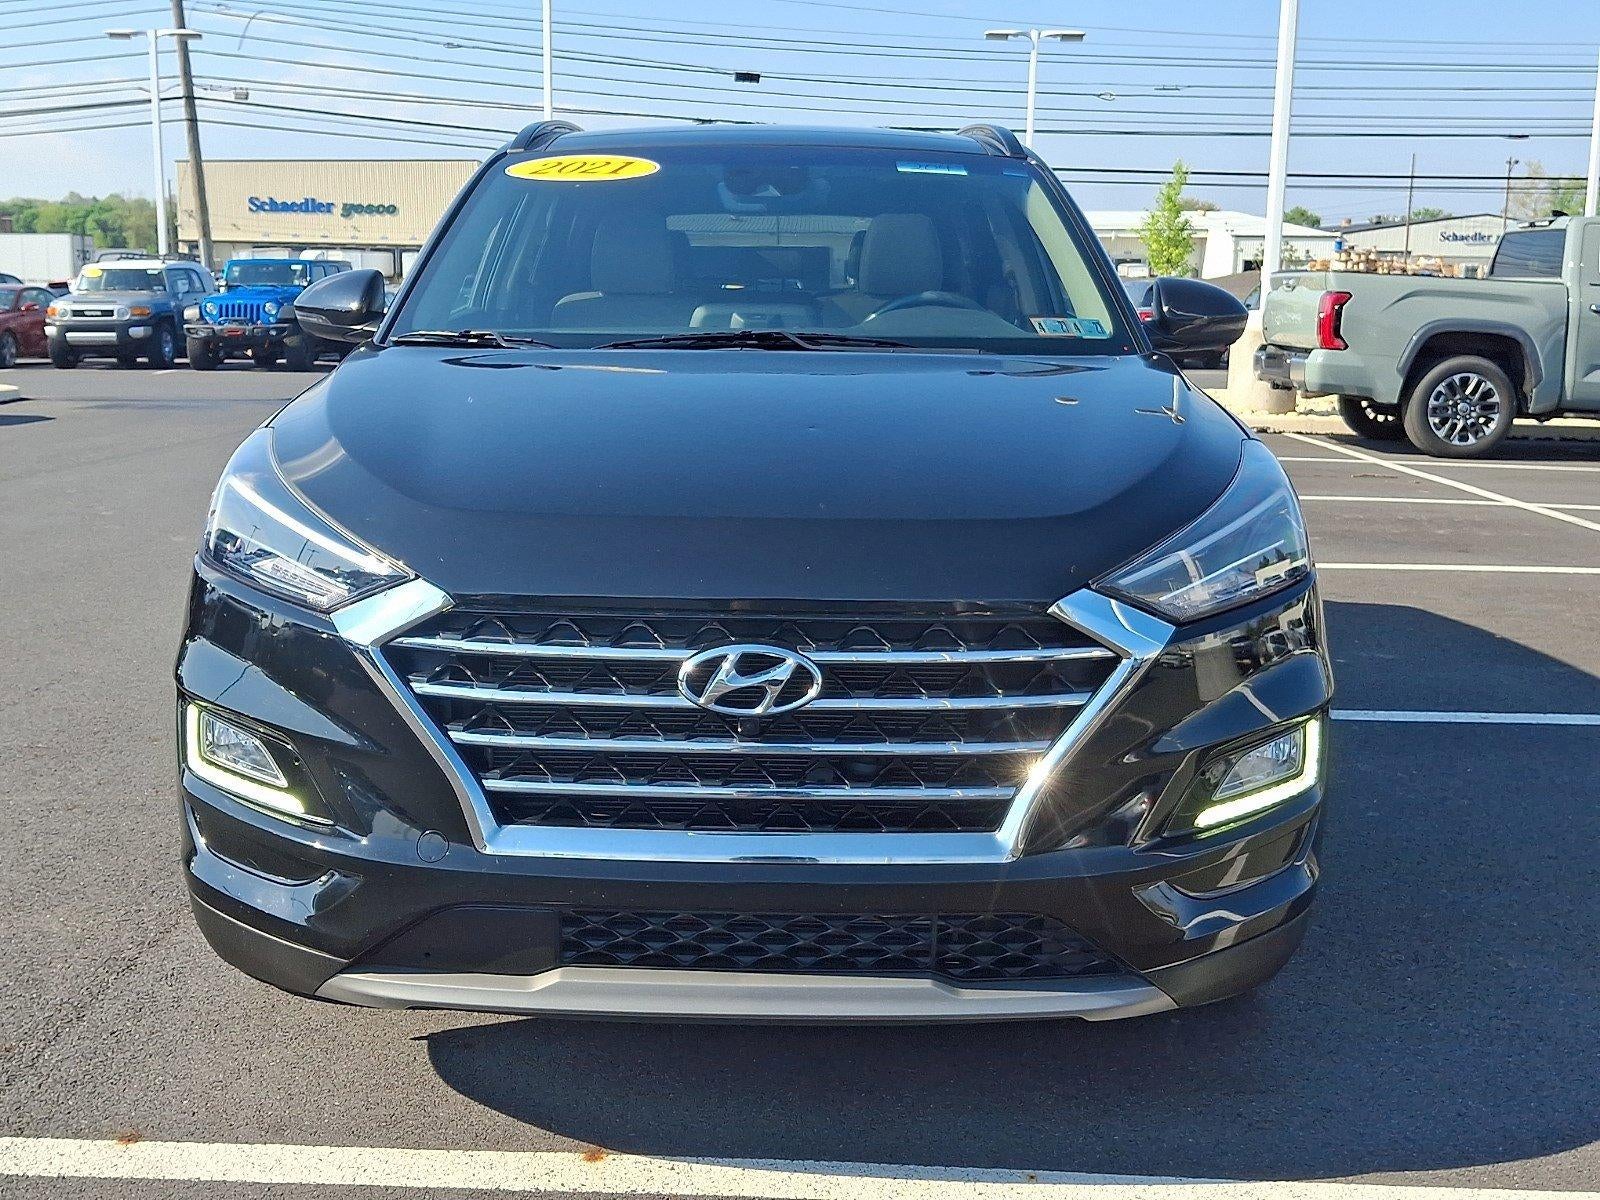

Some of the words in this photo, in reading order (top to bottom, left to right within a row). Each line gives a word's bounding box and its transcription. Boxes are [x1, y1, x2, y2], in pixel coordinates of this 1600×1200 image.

[528, 160, 635, 175] 2021
[247, 196, 335, 214] Schaedler
[1439, 231, 1493, 243] Schaedler
